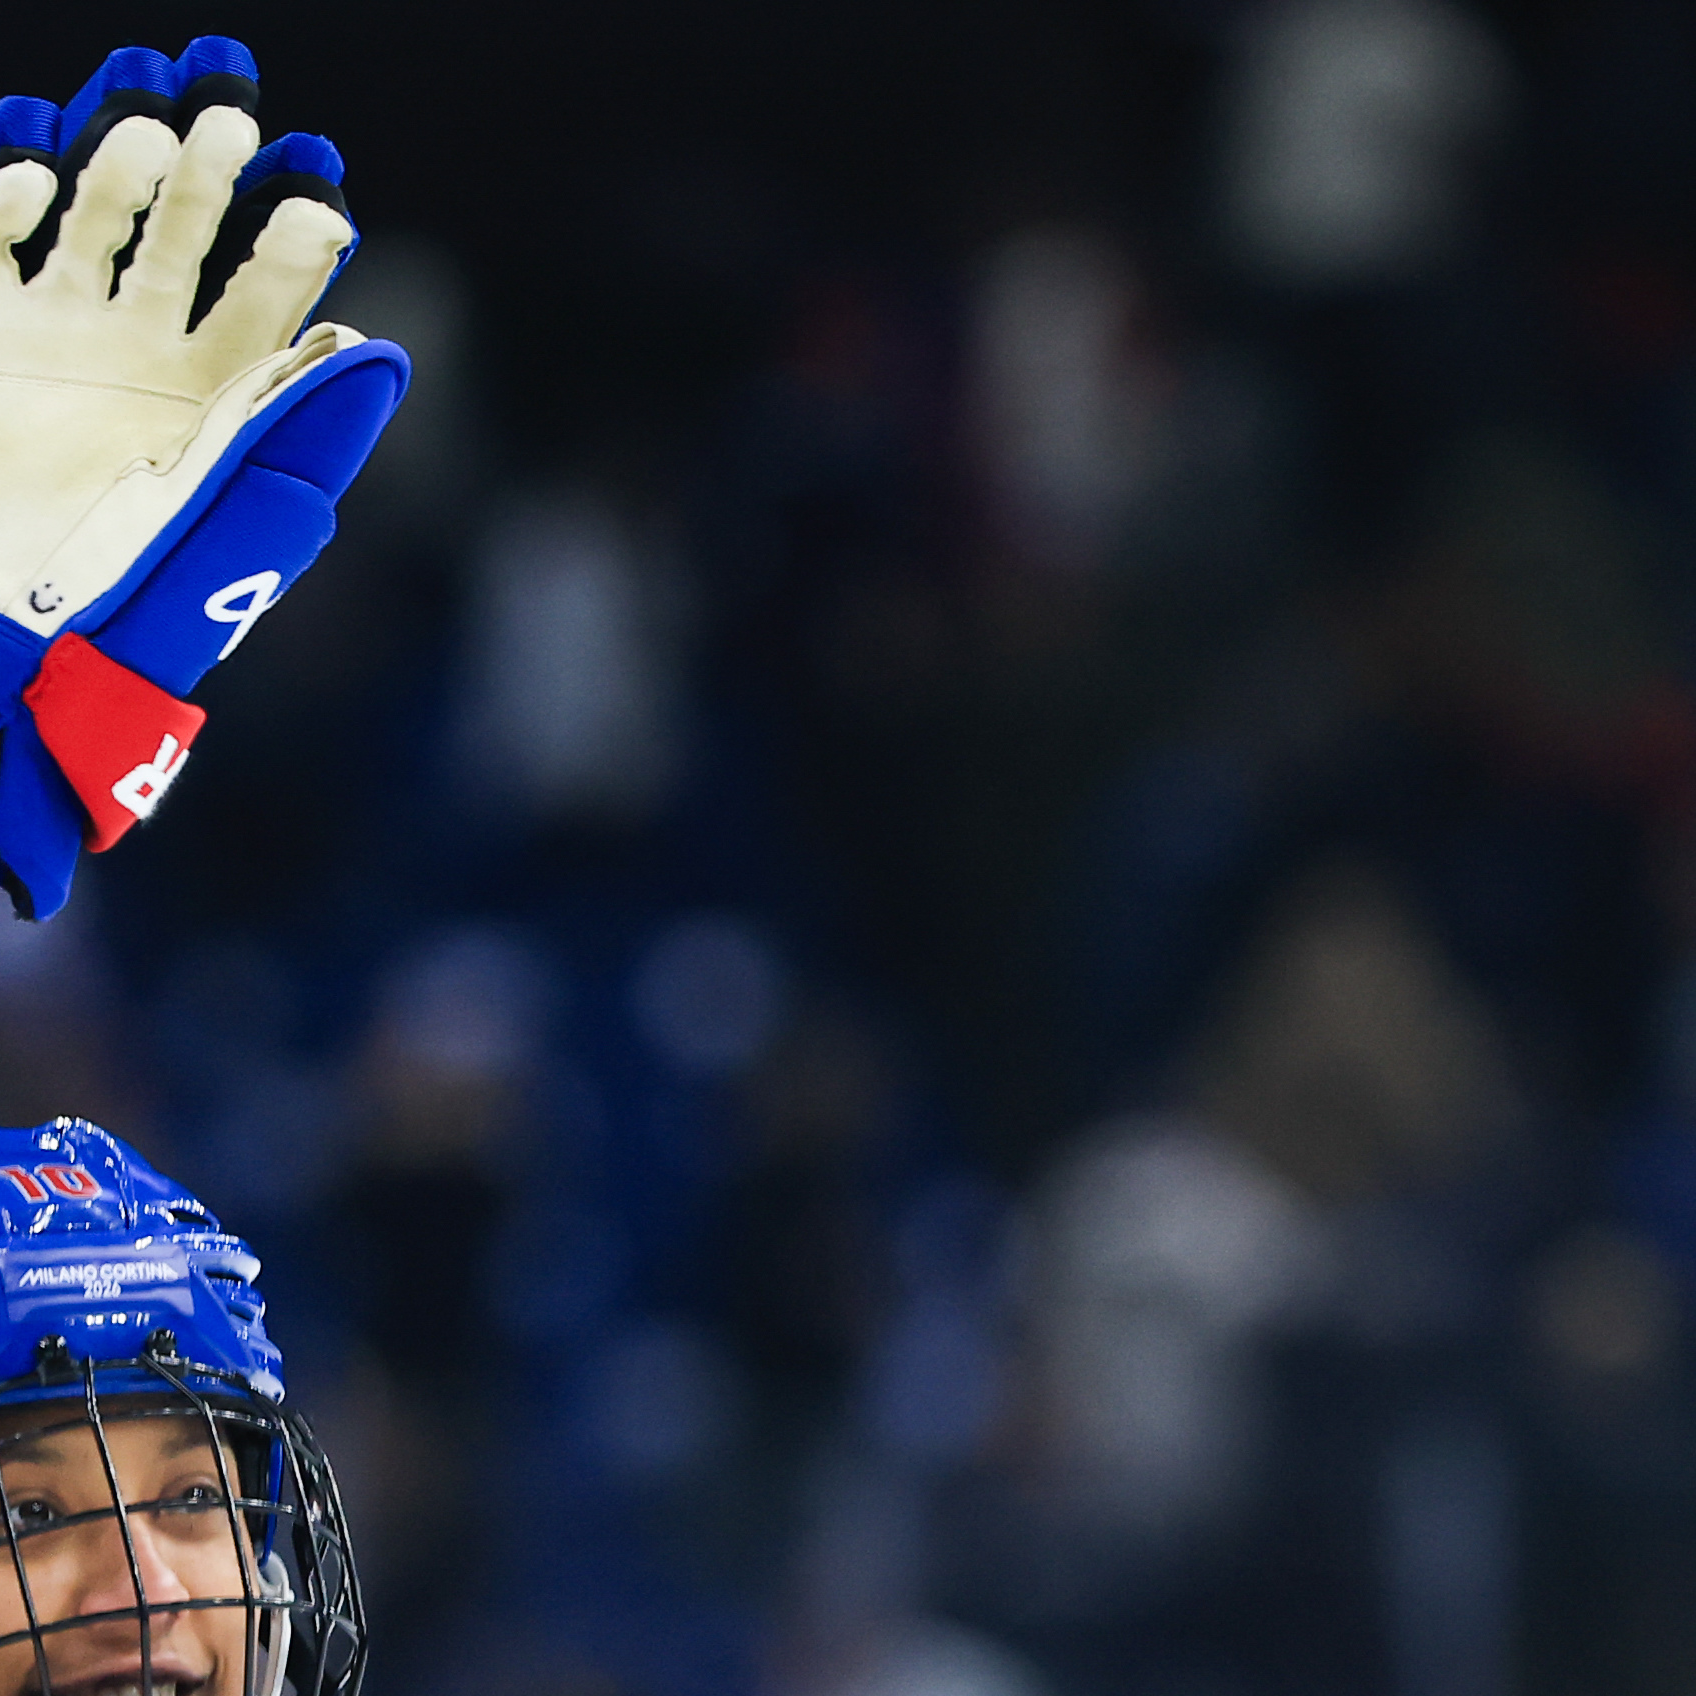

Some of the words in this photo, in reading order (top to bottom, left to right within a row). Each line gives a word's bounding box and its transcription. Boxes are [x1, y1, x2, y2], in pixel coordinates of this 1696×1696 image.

[19, 1264, 97, 1287] MILANO
[99, 1262, 179, 1281] CORTINA
[83, 1280, 122, 1299] 2026
